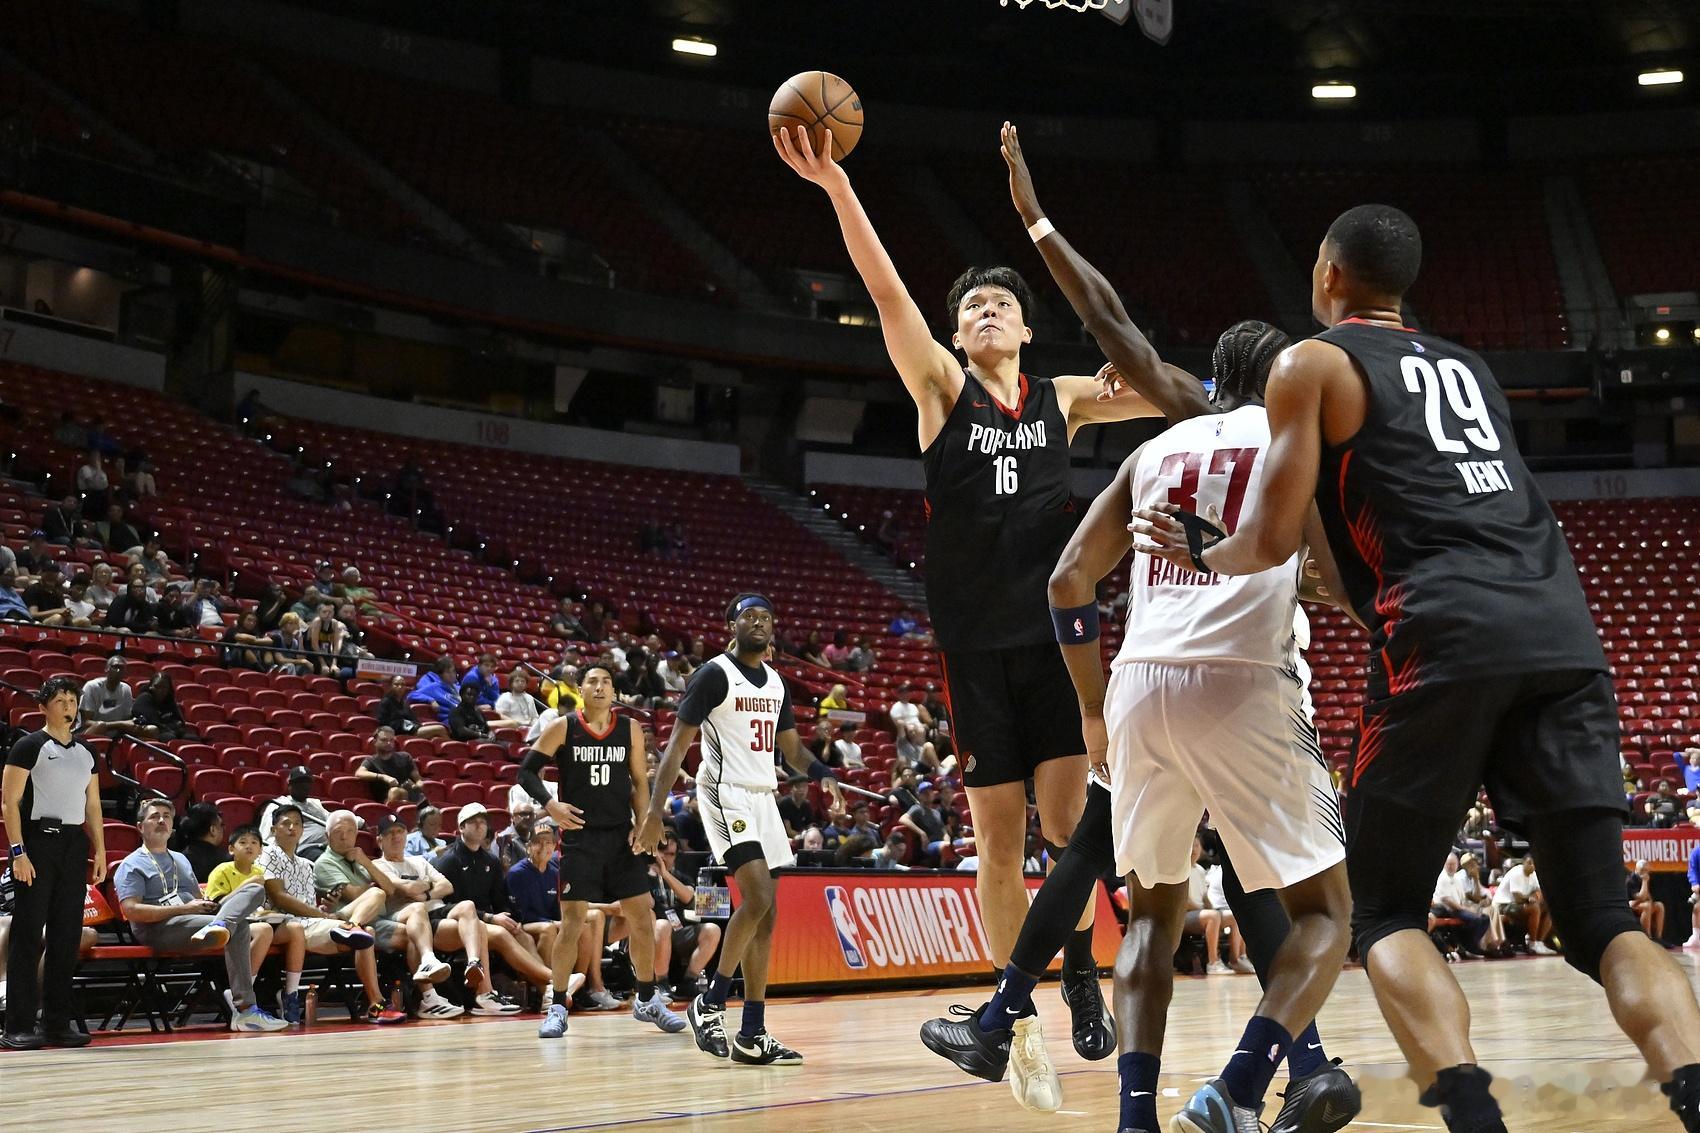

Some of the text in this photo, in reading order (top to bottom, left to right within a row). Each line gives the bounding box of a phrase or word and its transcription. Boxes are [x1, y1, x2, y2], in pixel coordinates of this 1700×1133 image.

[1399, 355, 1501, 454] 29
[478, 420, 510, 445] 108
[992, 455, 1019, 495] 16
[1158, 447, 1260, 537] 37
[1454, 460, 1514, 494] KENT
[1593, 474, 1628, 497] 110
[750, 719, 774, 753] 30
[572, 745, 626, 762] PORTLAND
[590, 763, 611, 786] 50
[1622, 839, 1679, 863] SUMMER
[853, 887, 980, 967] SUMMER
